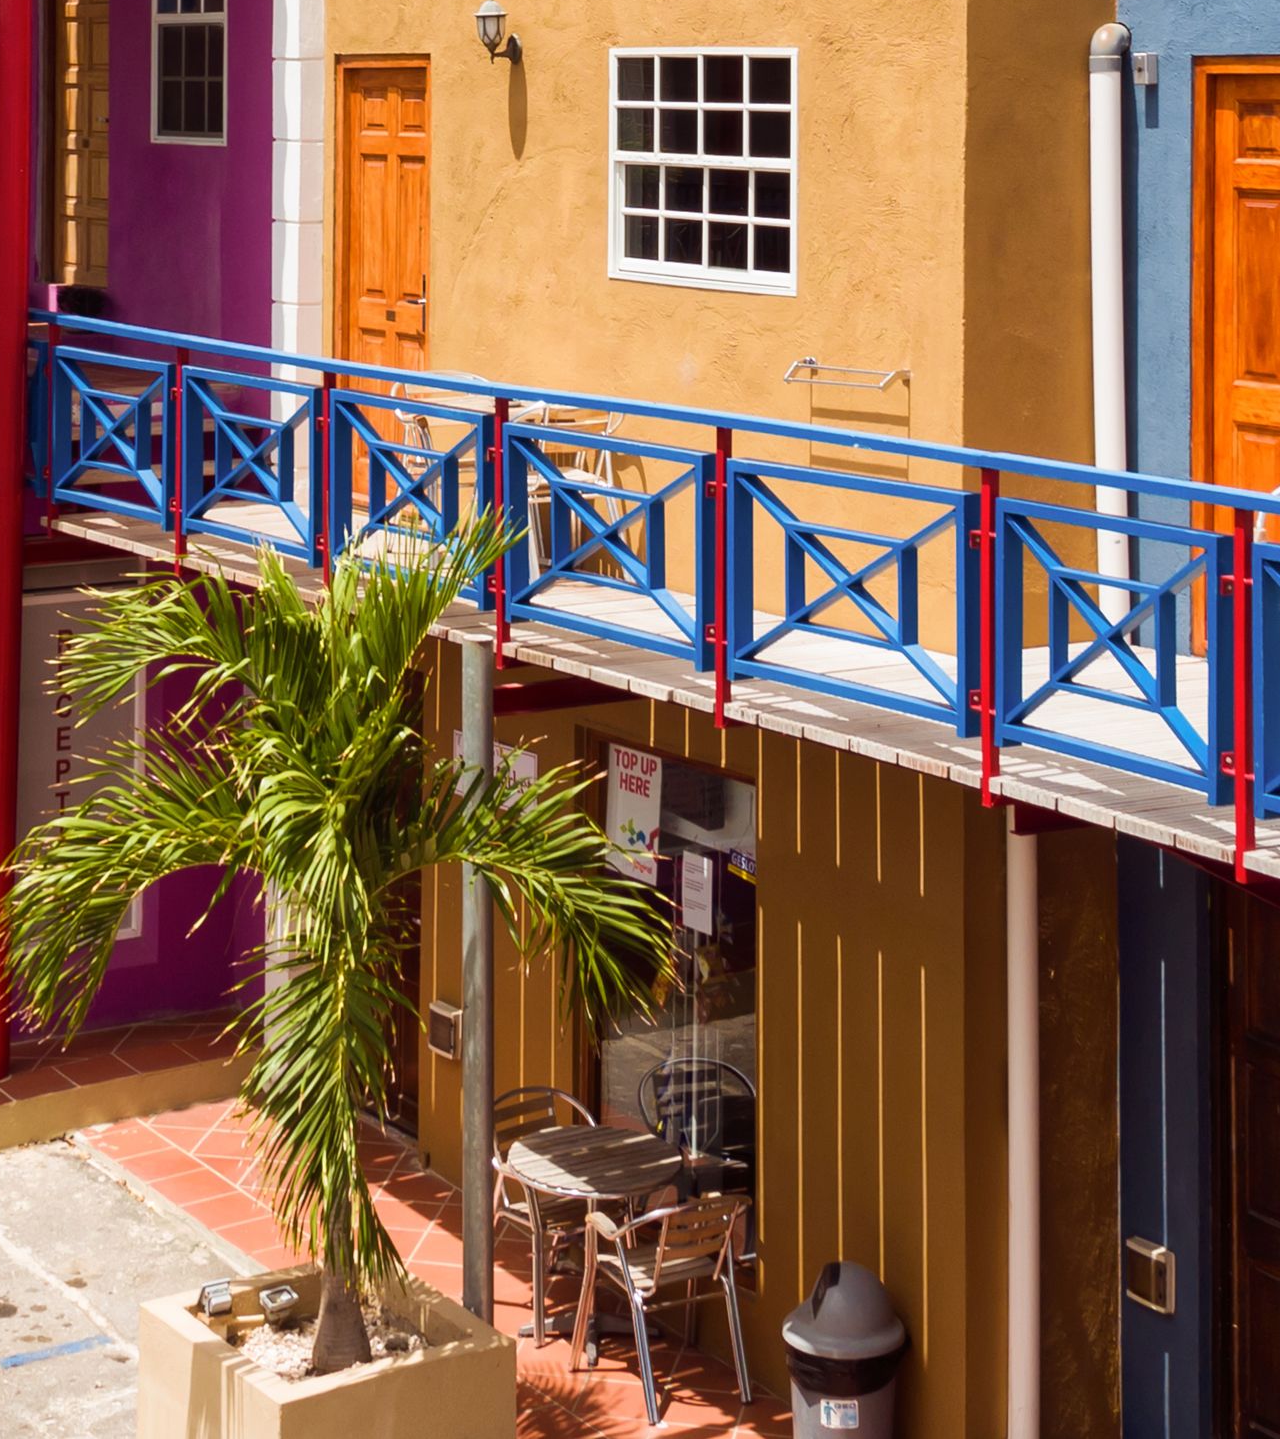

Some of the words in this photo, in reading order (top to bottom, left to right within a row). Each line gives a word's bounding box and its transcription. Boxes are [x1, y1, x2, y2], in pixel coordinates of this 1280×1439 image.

[614, 748, 638, 770] TOP
[640, 756, 658, 777] UP
[619, 771, 651, 798] HERE
